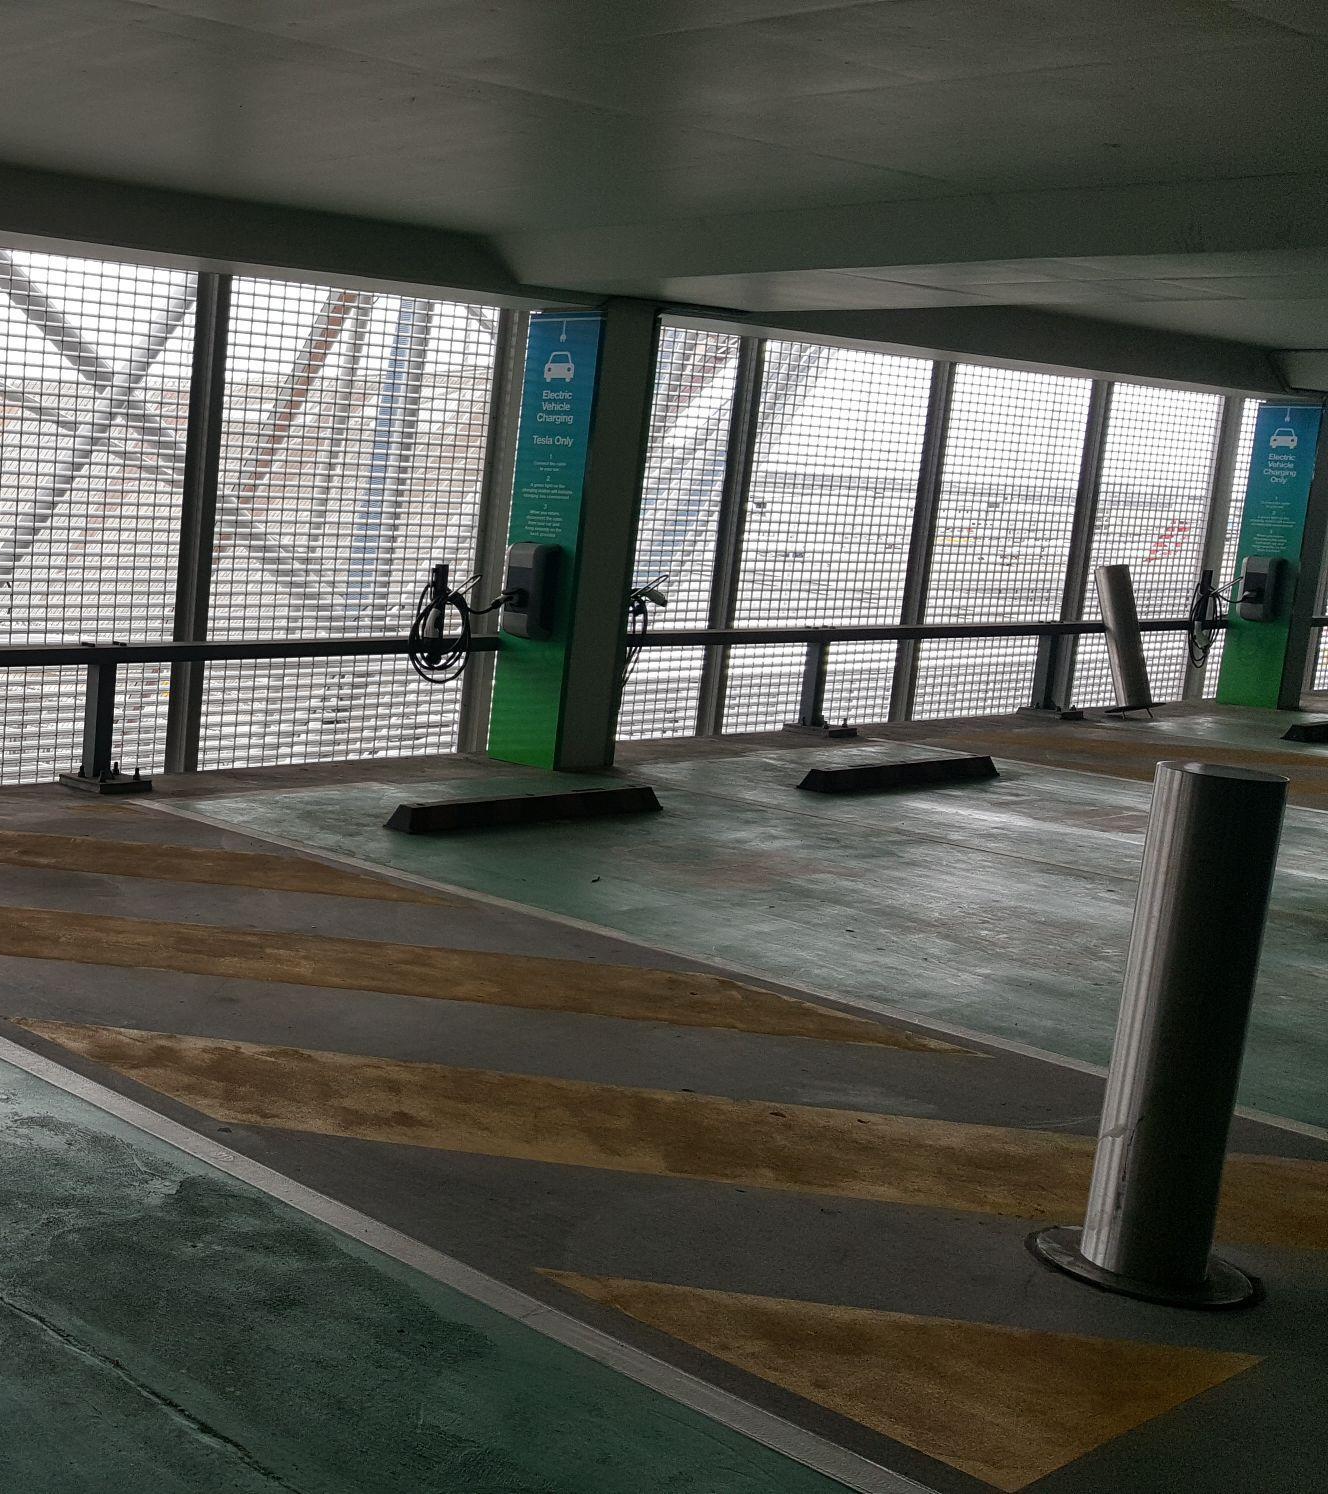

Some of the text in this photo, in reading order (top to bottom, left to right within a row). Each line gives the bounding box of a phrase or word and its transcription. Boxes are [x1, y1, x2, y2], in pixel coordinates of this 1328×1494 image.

[542, 390, 573, 399] Electric
[542, 402, 570, 411] Vehicle
[537, 413, 574, 424] Charging
[532, 435, 574, 447] Tesla Only
[1268, 453, 1296, 461] Electric
[1268, 461, 1294, 469] Vehicle
[1263, 469, 1297, 478] Charging
[1270, 476, 1287, 485] Only
